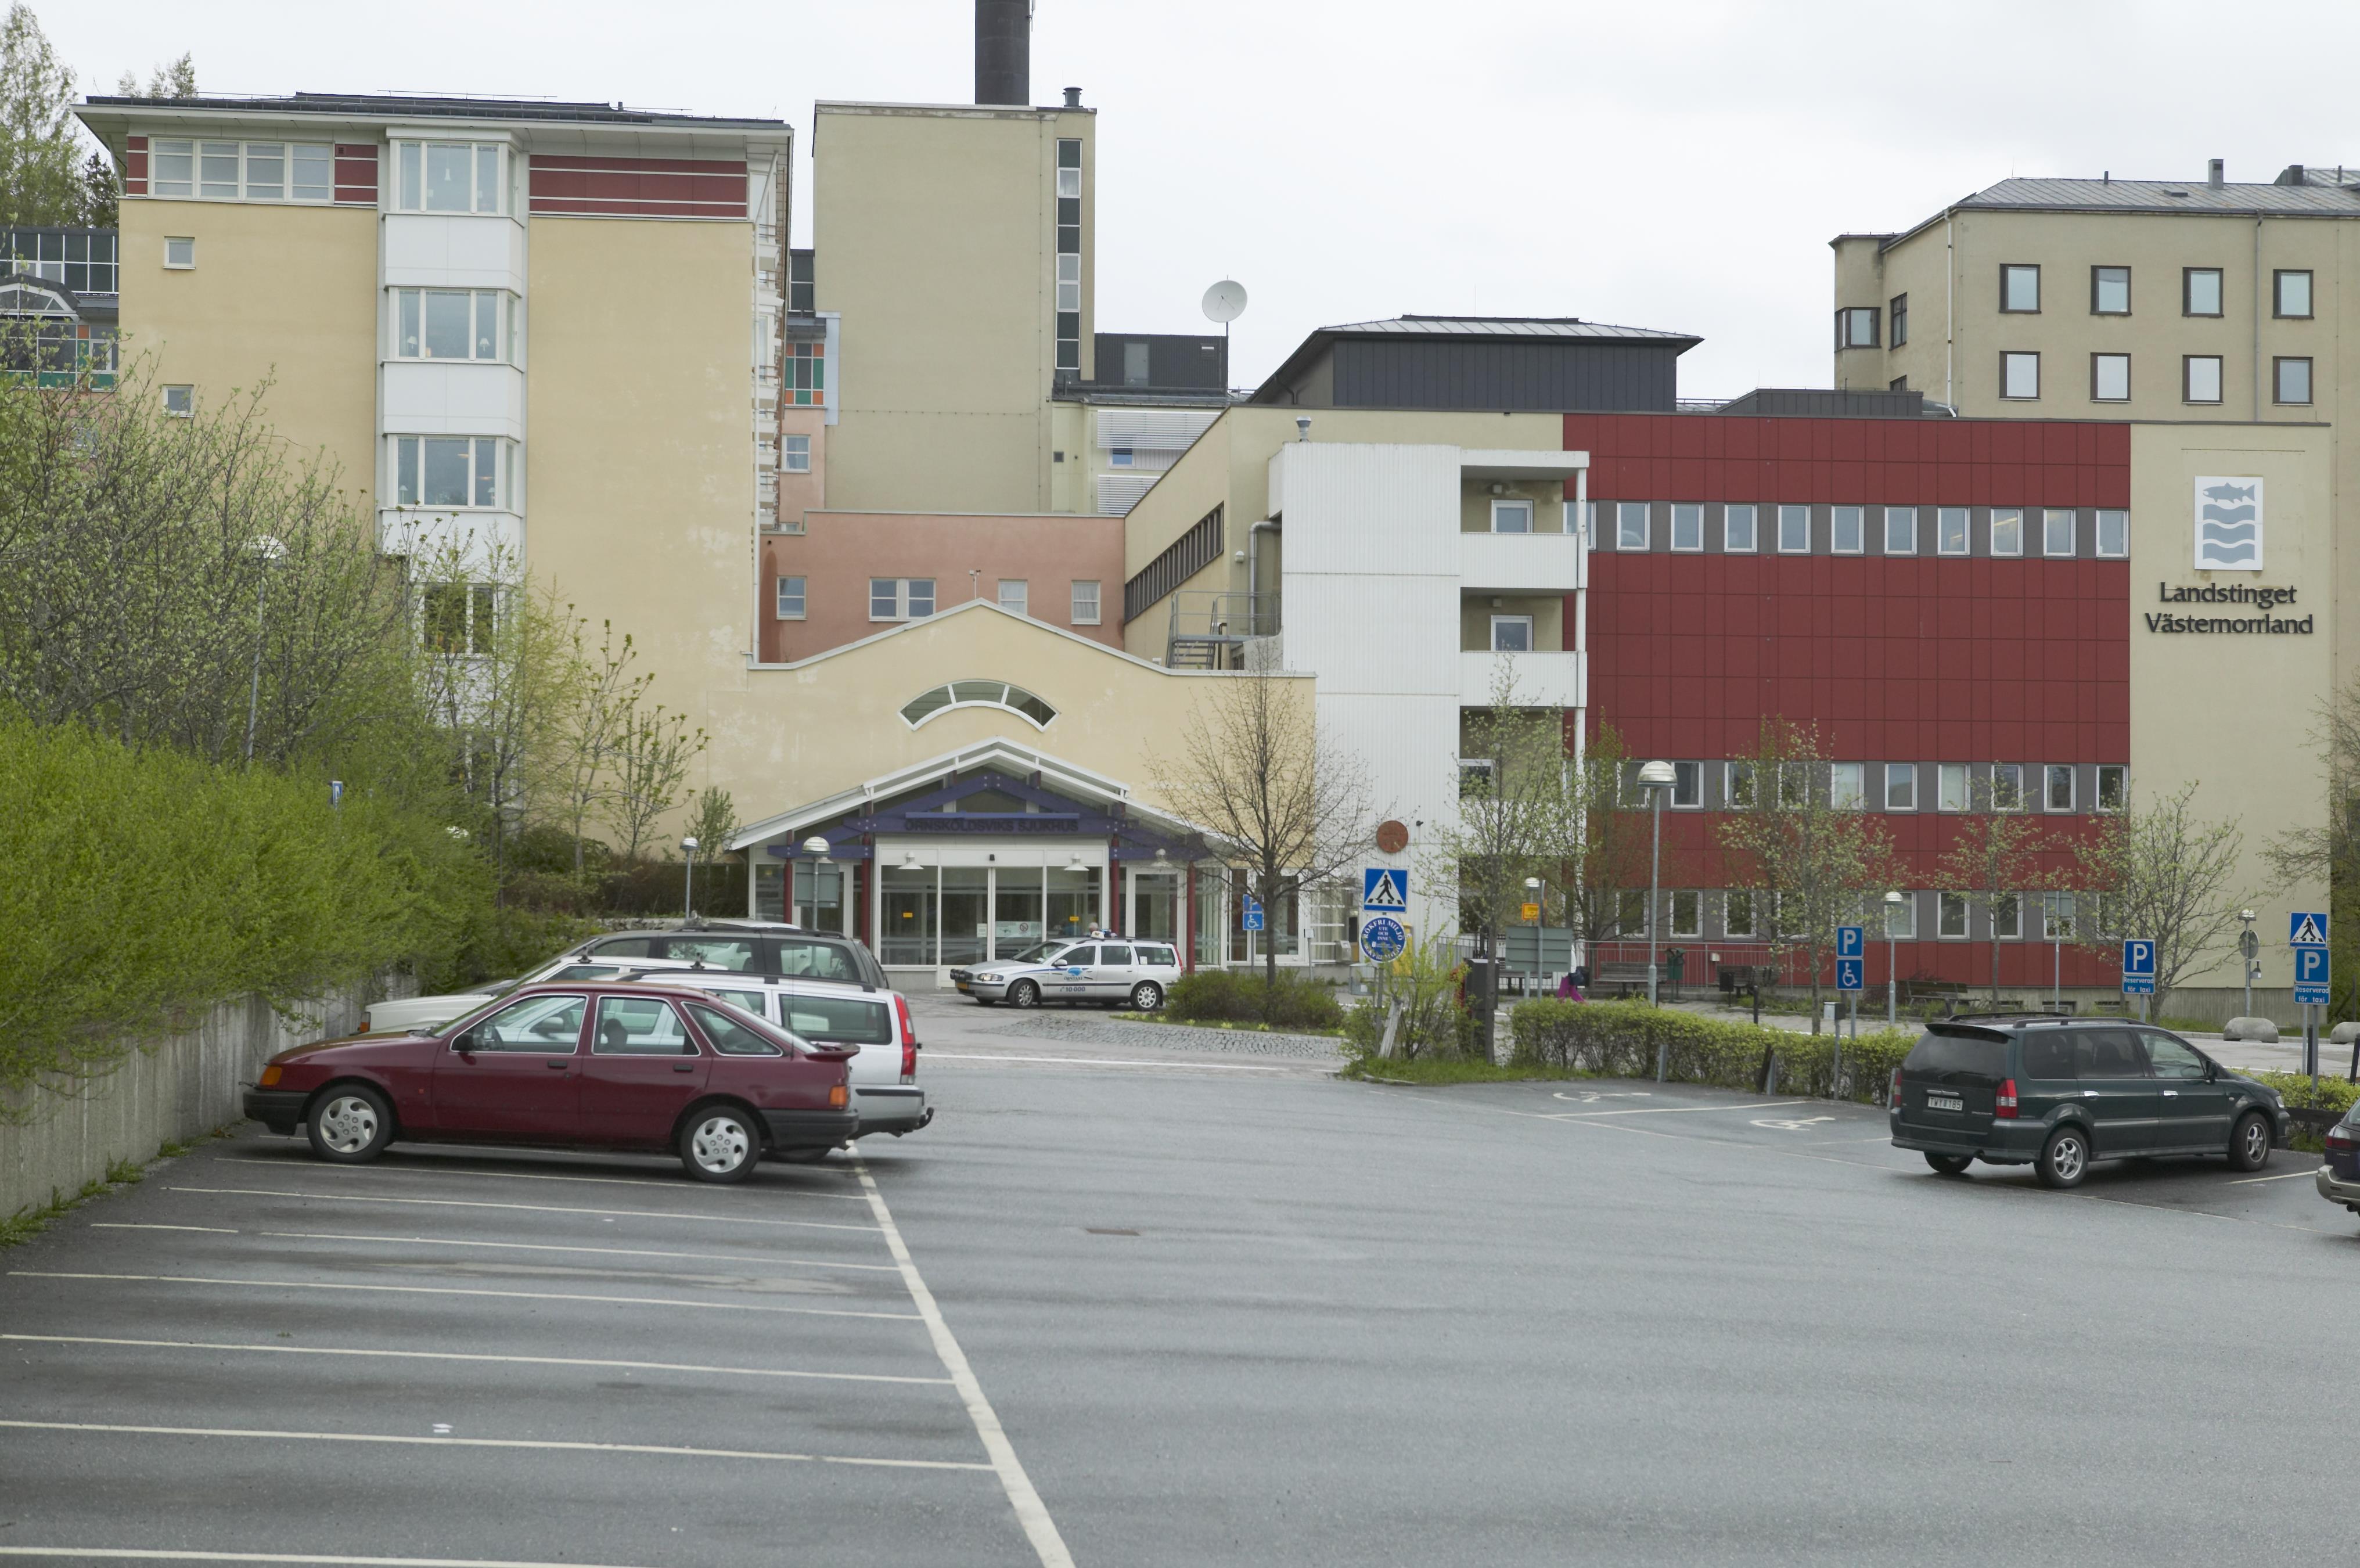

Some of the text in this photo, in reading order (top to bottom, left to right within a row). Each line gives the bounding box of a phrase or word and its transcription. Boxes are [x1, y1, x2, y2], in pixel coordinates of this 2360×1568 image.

[2160, 582, 2297, 609] Landstinget
[2145, 613, 2314, 634] Västernorrland
[1018, 819, 1078, 832] SJUKHUS
[1844, 929, 1857, 954] P
[2133, 944, 2148, 970] P
[2304, 951, 2320, 979] P
[2295, 986, 2329, 994] Reserverad
[1930, 1098, 1961, 1109] TWY 185
